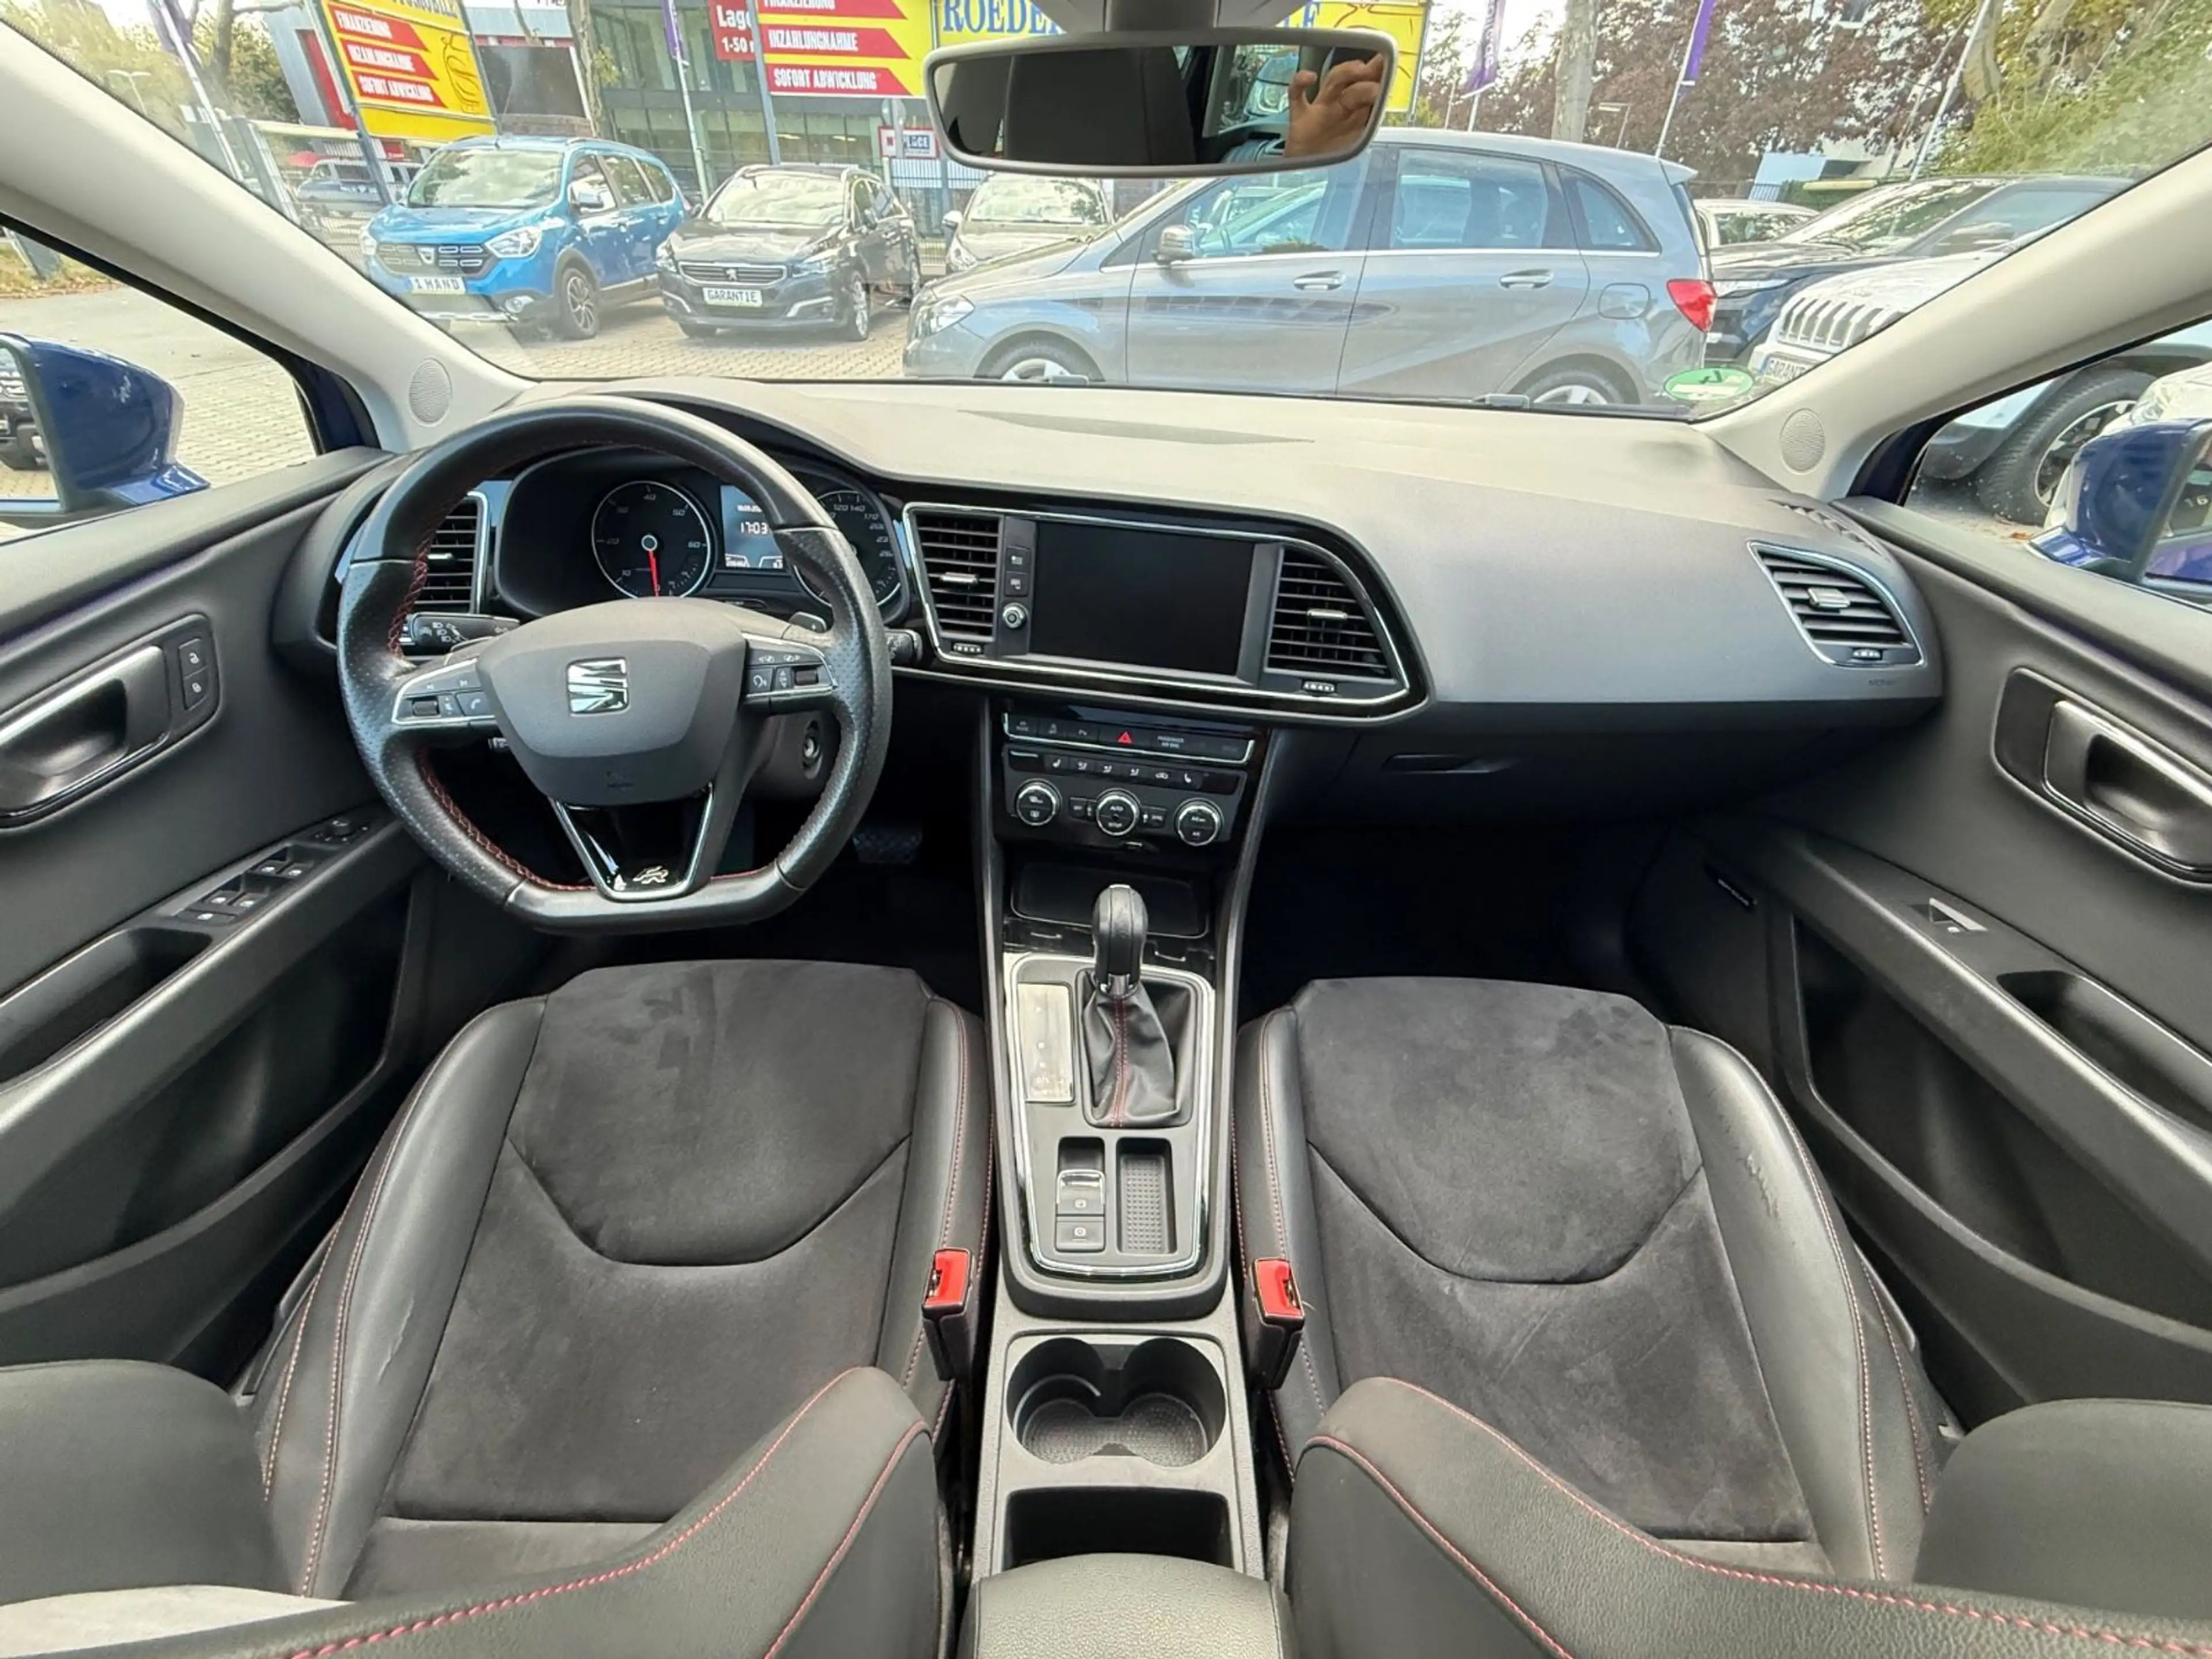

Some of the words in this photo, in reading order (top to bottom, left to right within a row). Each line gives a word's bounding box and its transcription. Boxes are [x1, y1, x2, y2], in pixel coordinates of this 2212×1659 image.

[721, 36, 748, 54] 1-50
[774, 68, 810, 88] SOFORT
[813, 70, 877, 90] ABWICKLUNG
[707, 289, 758, 303] GARANTIE
